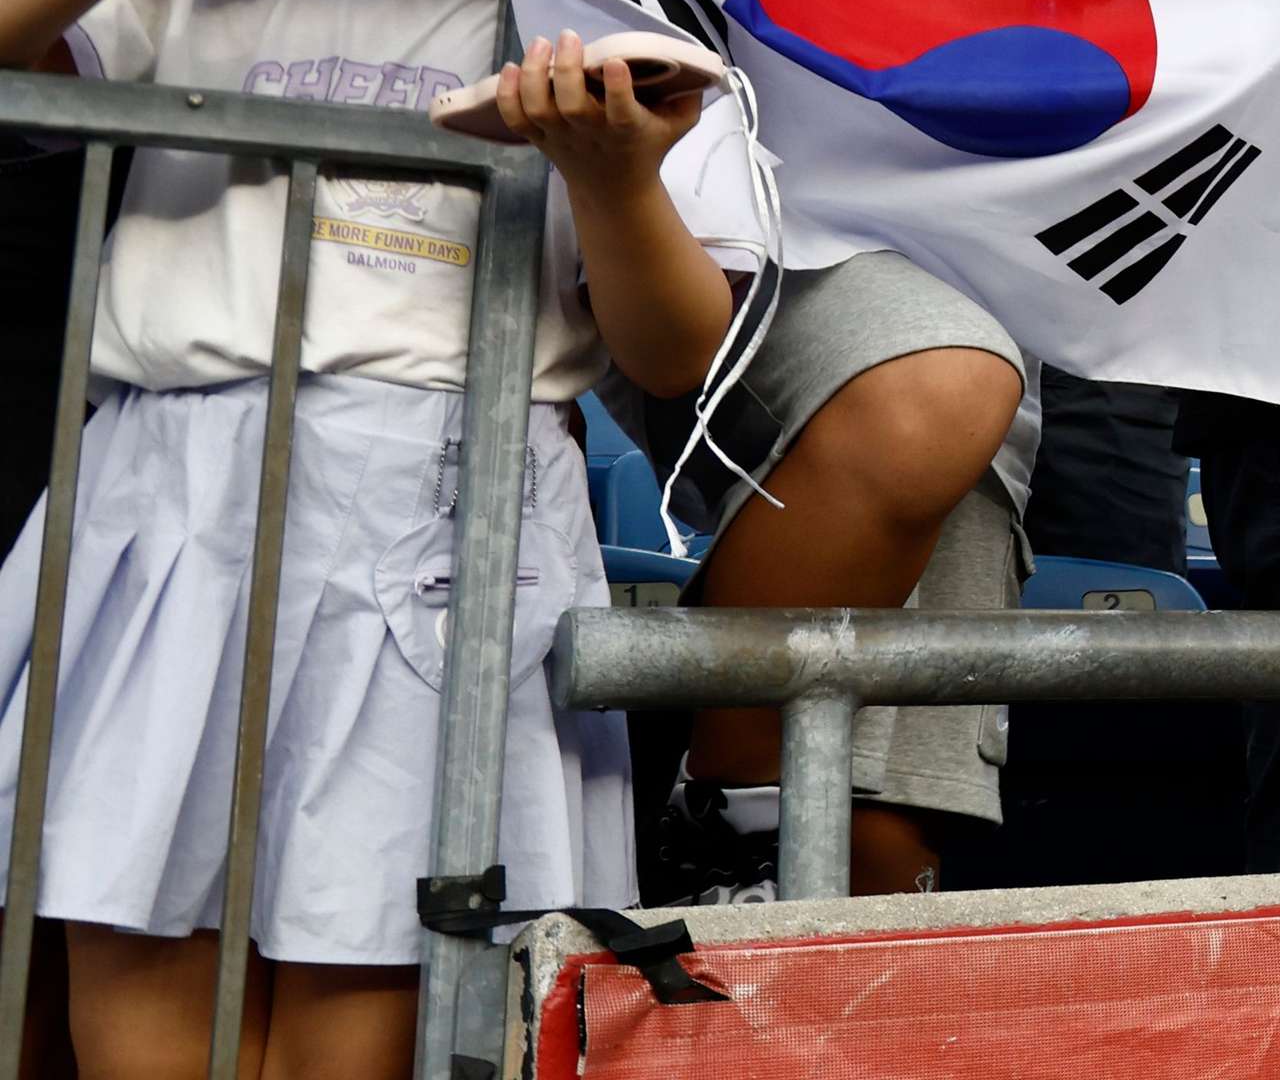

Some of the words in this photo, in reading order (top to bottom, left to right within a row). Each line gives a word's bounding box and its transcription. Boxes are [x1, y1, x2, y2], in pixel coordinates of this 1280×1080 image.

[329, 223, 370, 243] MORE
[374, 231, 425, 253] FUNNY
[427, 240, 462, 262] DAYS
